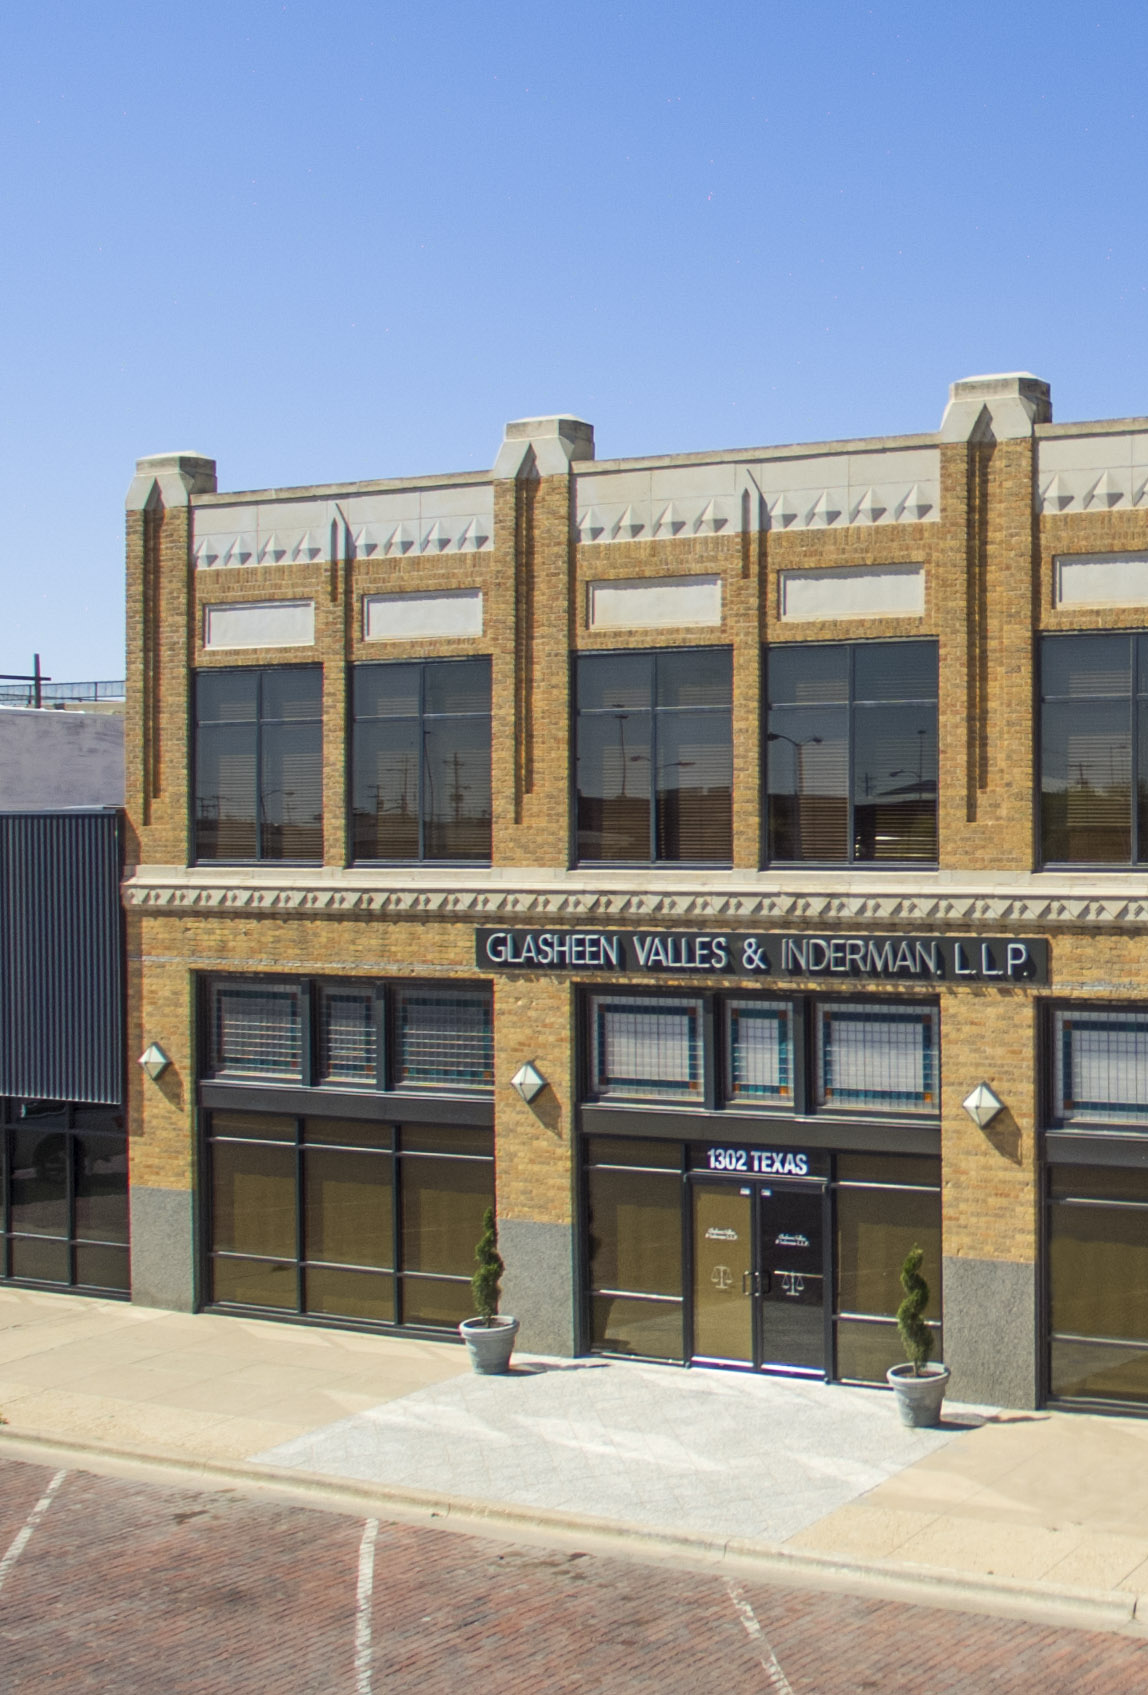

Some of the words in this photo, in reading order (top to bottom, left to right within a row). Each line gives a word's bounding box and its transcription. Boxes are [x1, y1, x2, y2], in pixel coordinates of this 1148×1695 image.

[486, 932, 618, 965] GLASHEEN
[633, 935, 728, 968] VALLES
[742, 937, 768, 969] &
[707, 1148, 747, 1171] 1302
[751, 1150, 808, 1175] TEXAS
